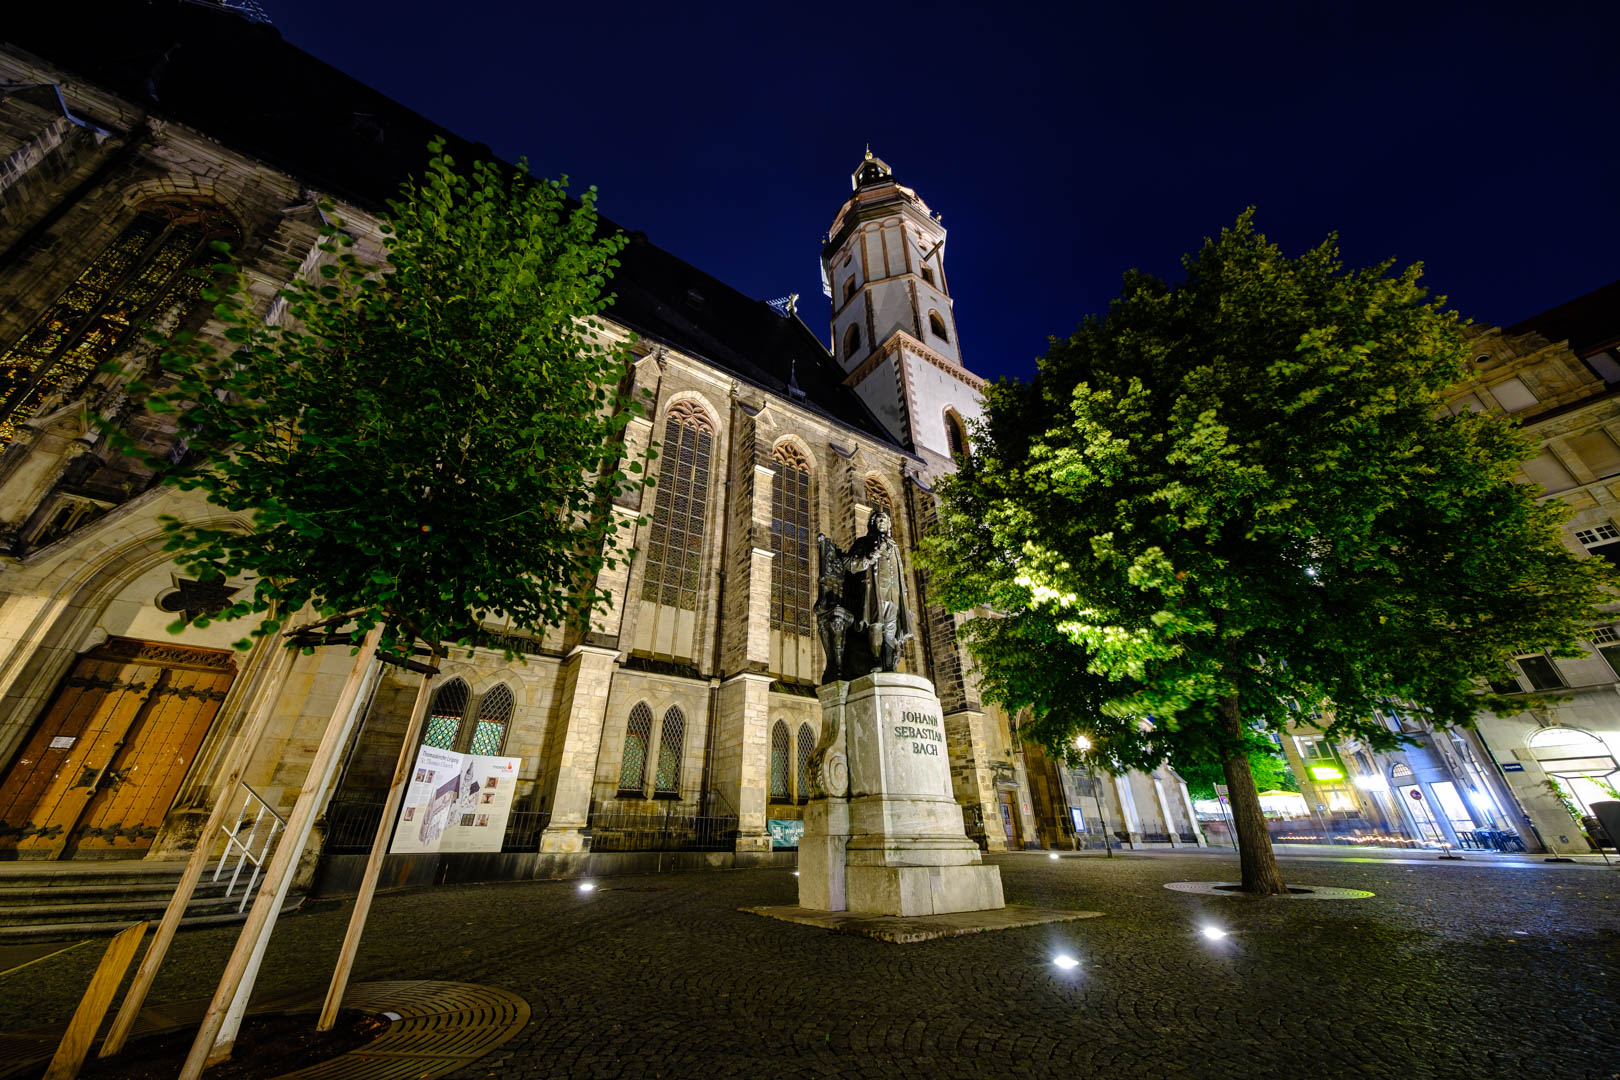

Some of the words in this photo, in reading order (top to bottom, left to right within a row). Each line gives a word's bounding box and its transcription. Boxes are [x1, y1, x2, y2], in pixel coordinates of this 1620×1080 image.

[901, 711, 938, 727] JOHANN
[894, 726, 942, 743] SEBASTIAN
[912, 742, 938, 756] BACH
